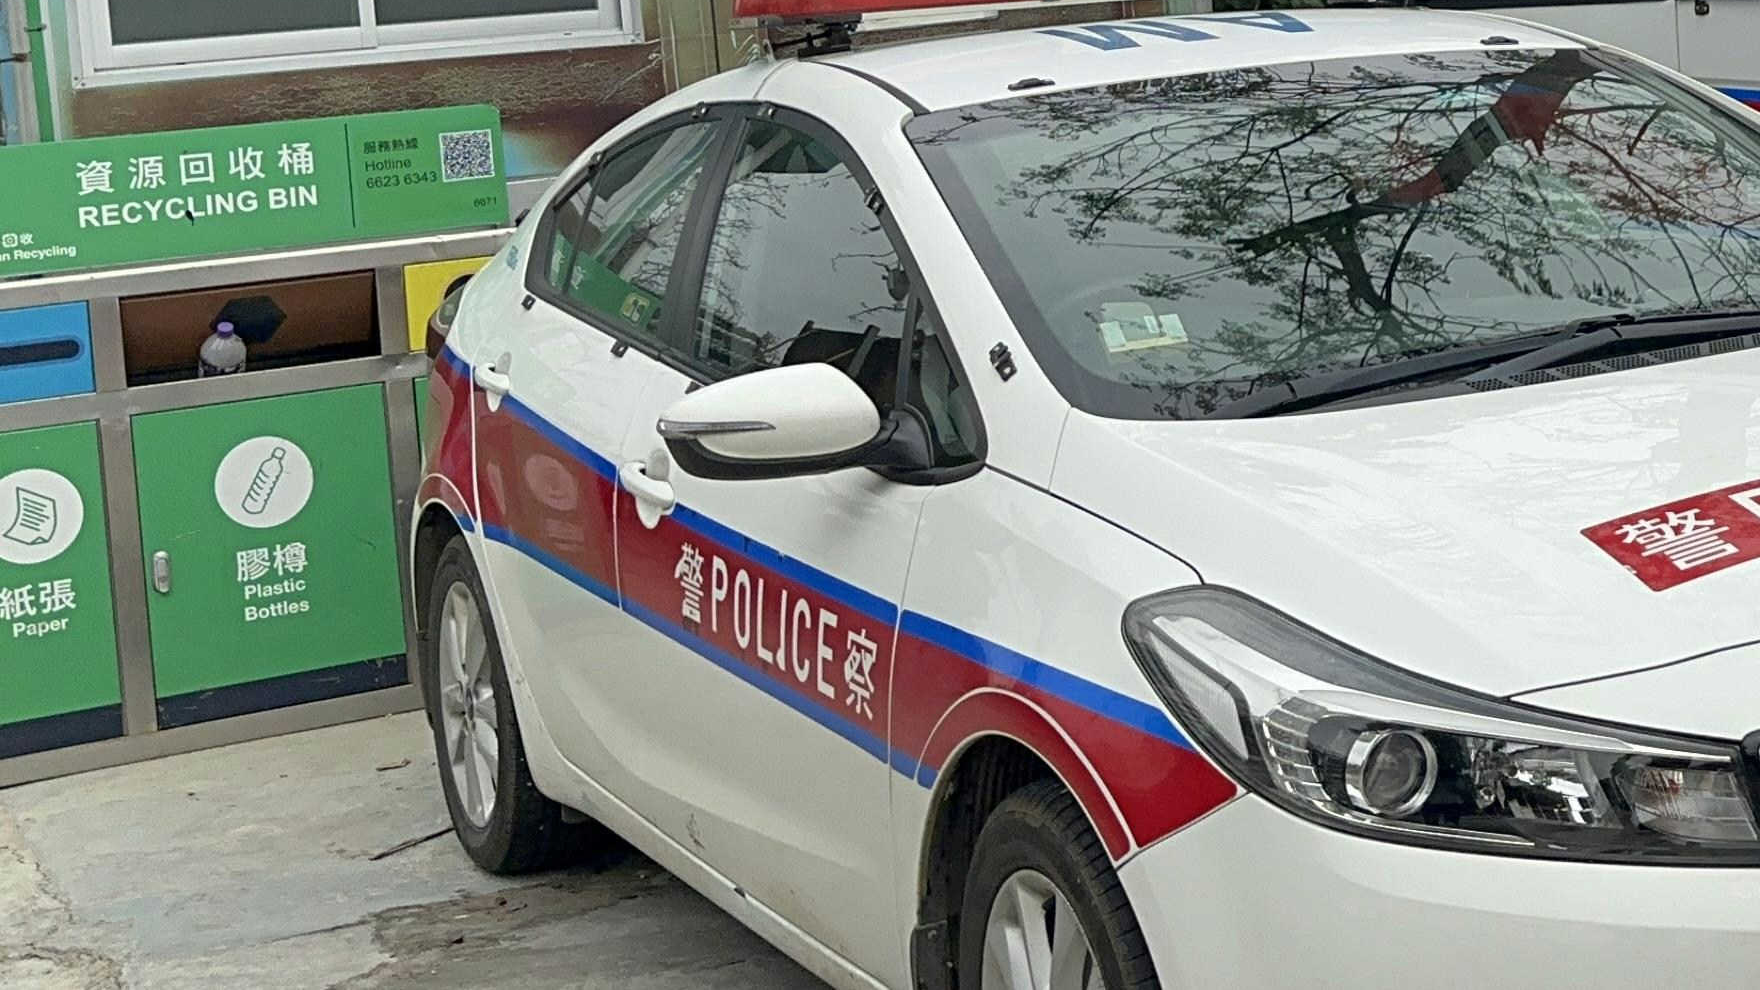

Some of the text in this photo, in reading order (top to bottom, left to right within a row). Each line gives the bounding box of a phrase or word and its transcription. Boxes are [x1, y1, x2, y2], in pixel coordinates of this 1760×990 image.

[76, 142, 315, 196] 資源回收桶
[365, 158, 412, 172] Hotline
[366, 171, 437, 189] 6623 6343
[78, 185, 318, 228] RECYCLING BIN
[14, 245, 77, 260] Recycling
[236, 541, 308, 582] 膠樽
[0, 577, 77, 620] 紙張
[244, 578, 306, 600] Plastic
[244, 600, 310, 622] Bottles
[12, 617, 69, 638] Paper
